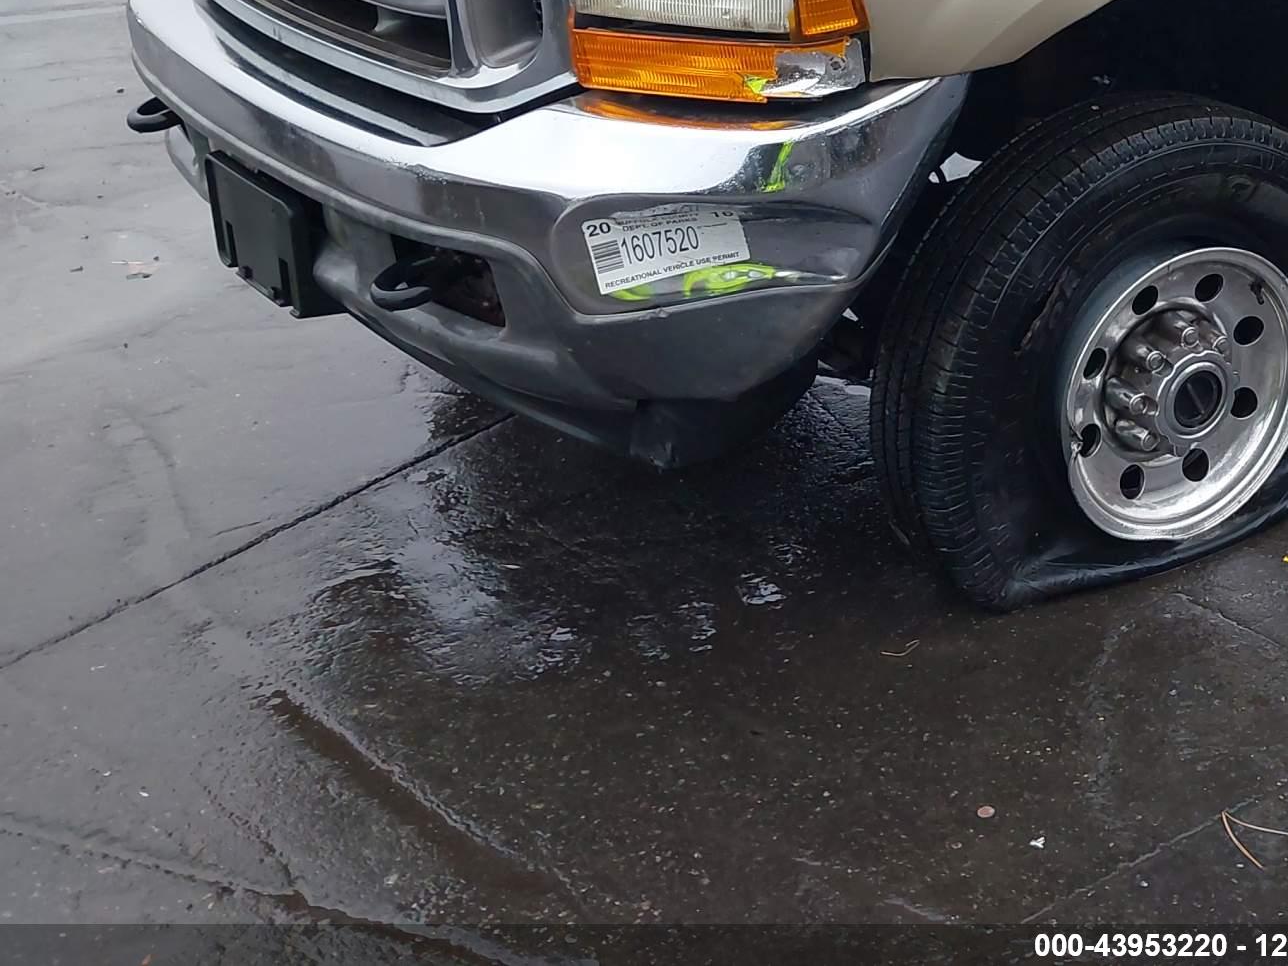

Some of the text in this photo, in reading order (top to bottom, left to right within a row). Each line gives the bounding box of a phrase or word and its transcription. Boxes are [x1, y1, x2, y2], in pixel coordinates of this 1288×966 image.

[586, 221, 611, 238] 20
[621, 225, 700, 265] 1607520
[605, 251, 740, 289] RECREATIONAL VEHICLE USE PERMIT
